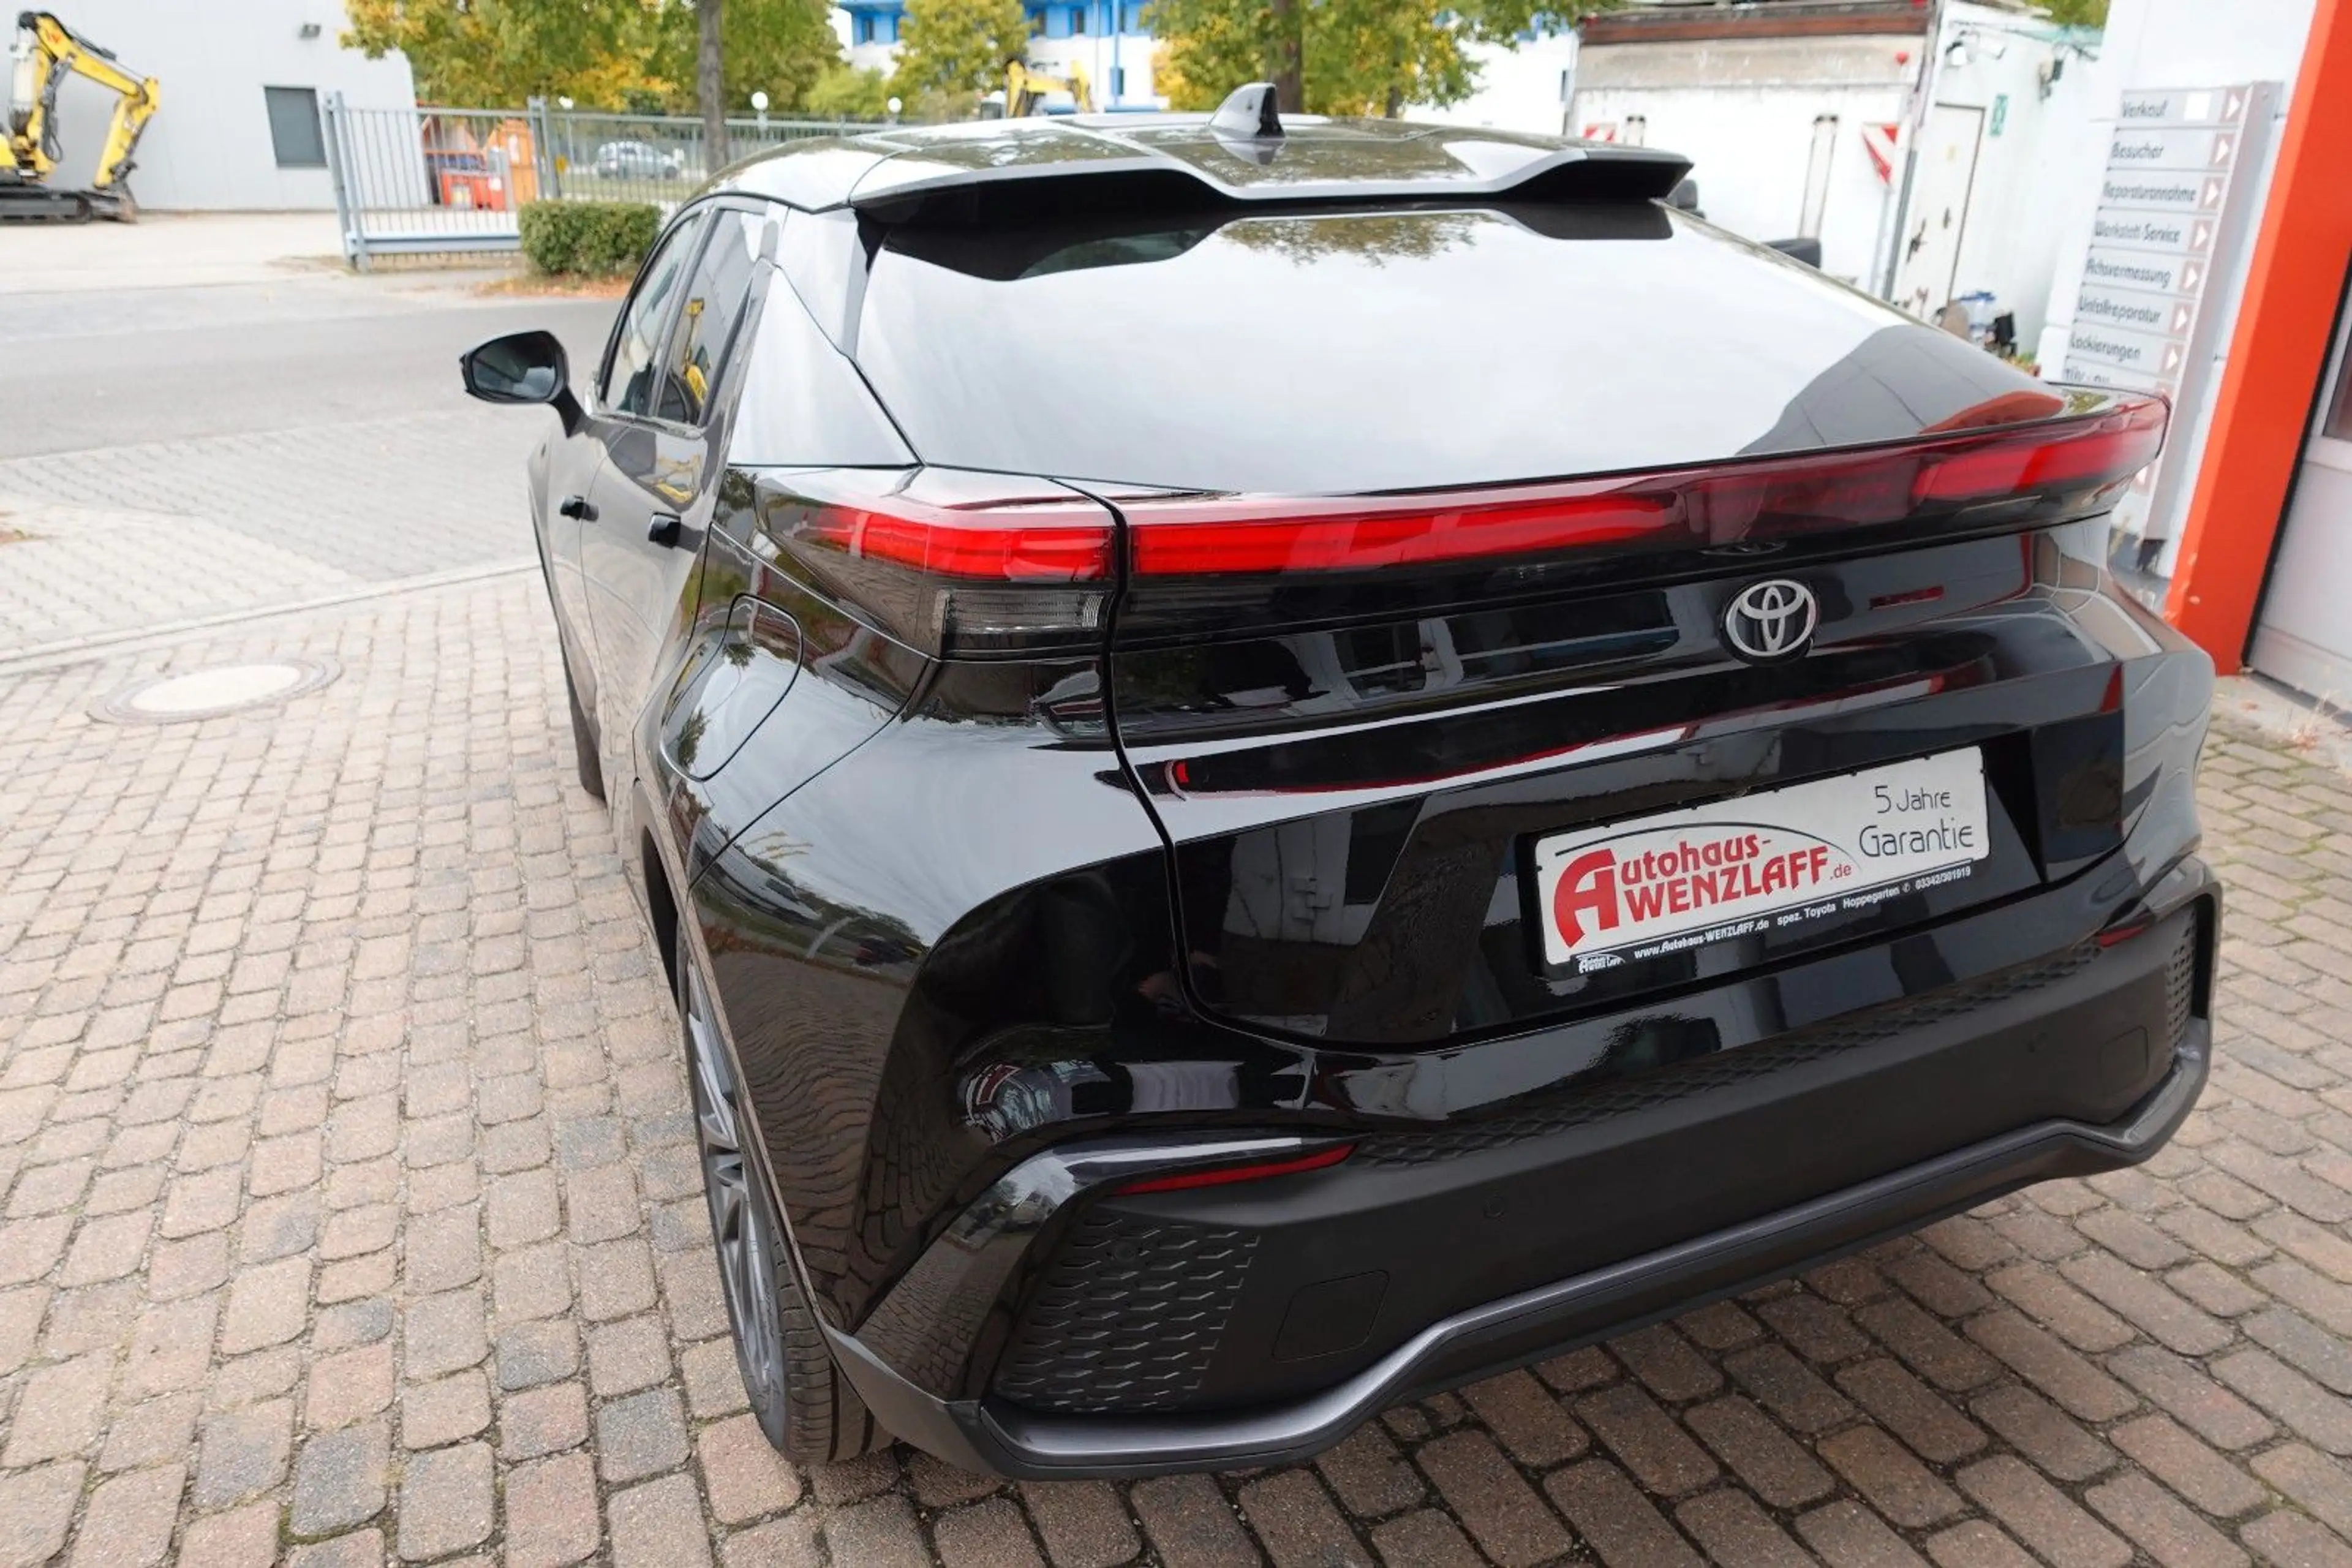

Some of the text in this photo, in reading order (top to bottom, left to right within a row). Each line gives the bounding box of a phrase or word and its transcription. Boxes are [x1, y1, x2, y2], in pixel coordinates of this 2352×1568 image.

[2122, 99, 2168, 118] Verkauf
[2111, 141, 2164, 159] Besucher
[2070, 332, 2141, 362] Lackierungen
[1874, 785, 1951, 813] 5 Jahre
[1859, 816, 1974, 857] Garantie
[1804, 903, 1836, 919] Toyota
[1843, 886, 1900, 910] Hoppegarten
